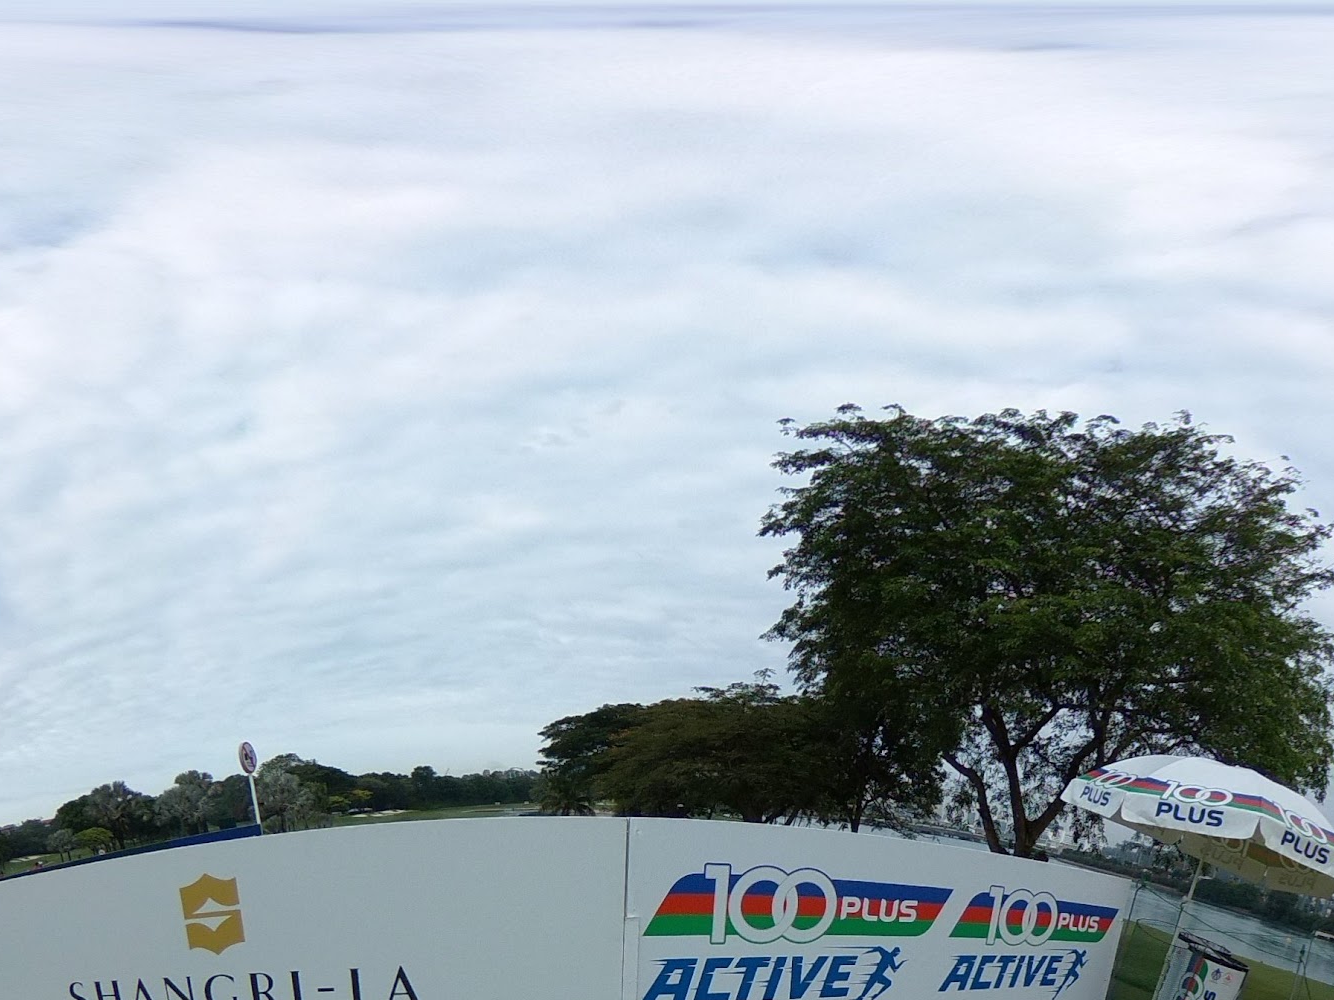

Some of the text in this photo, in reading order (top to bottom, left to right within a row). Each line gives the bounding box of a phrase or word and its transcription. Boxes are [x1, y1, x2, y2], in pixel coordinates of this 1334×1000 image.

[1080, 786, 1112, 807] PLUS
[1160, 780, 1233, 806] 100
[1155, 802, 1225, 828] PLUS
[1281, 831, 1330, 865] PLUS
[704, 863, 919, 944] 100 PLUS
[985, 885, 1101, 946] 100 PLUS
[937, 955, 1065, 992] ACTIVE
